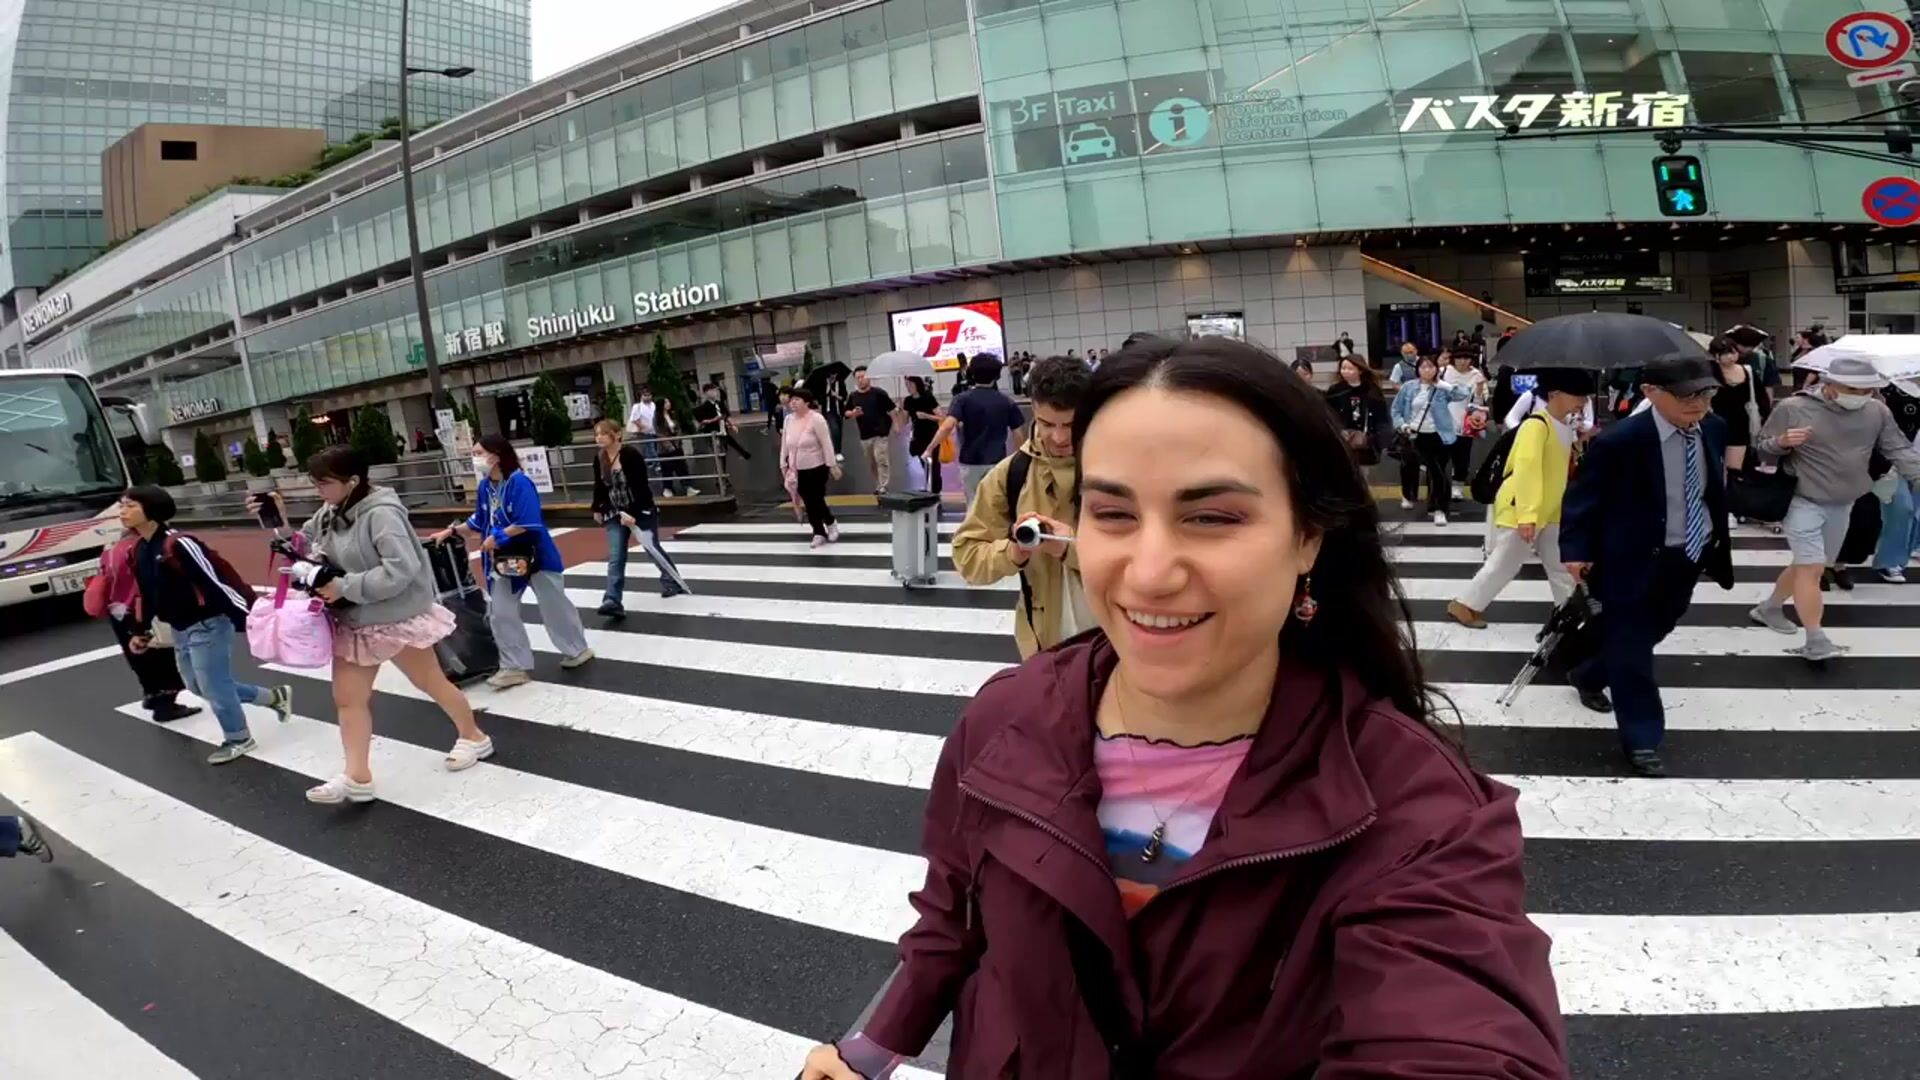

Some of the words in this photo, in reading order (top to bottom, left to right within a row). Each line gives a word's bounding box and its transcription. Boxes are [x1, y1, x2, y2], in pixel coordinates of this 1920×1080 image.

[1012, 97, 1047, 125] 3F
[1060, 91, 1117, 117] Taxi
[1223, 88, 1281, 104] Tokyo
[1223, 99, 1297, 119] Tourist
[1223, 109, 1348, 130] Information
[1399, 91, 1690, 132] バスタ新宿
[1225, 126, 1296, 141] Center
[527, 304, 616, 338] Shinjuku
[633, 282, 720, 316] Station
[444, 320, 505, 356] 新宿駅
